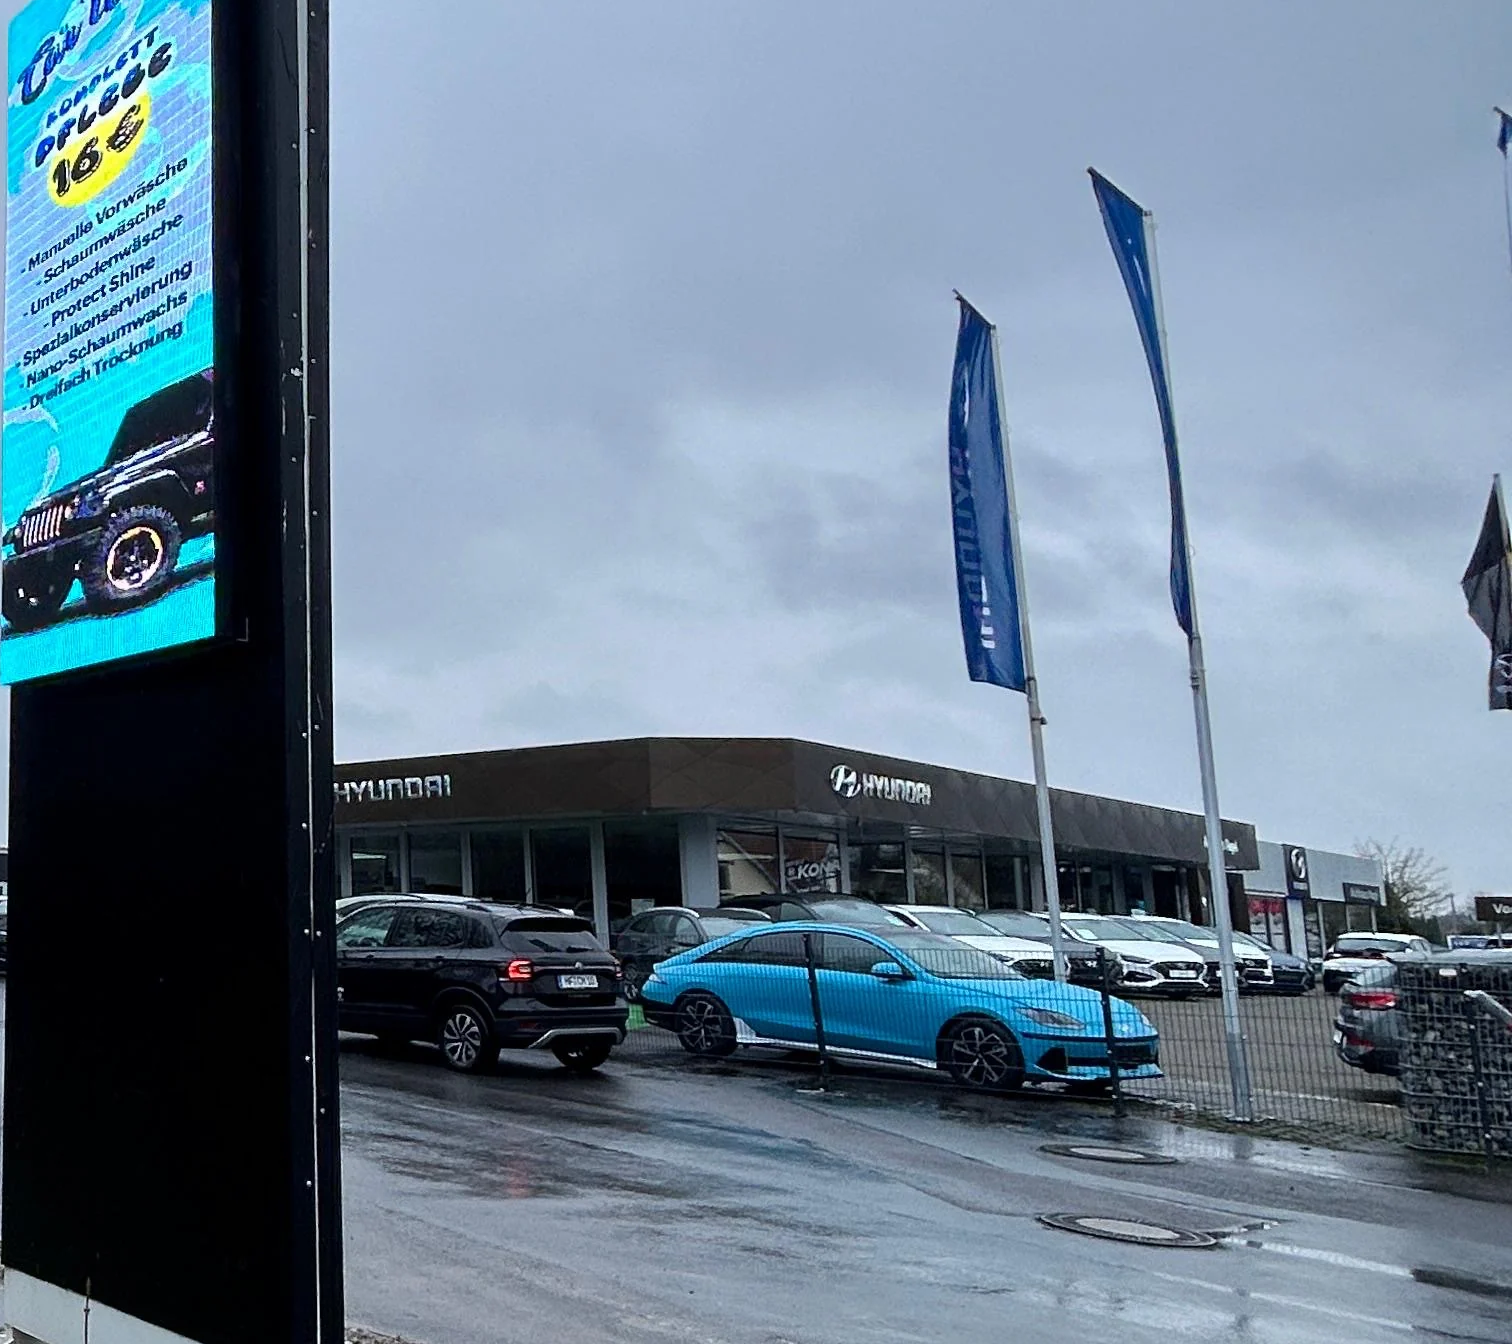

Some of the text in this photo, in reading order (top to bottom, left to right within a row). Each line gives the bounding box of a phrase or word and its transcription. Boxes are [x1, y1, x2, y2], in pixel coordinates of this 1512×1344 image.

[35, 42, 172, 168] PFLEGE
[45, 25, 159, 129] KOMPLETT
[53, 104, 145, 197] 16 €
[27, 157, 188, 271] Manuelle Vorwäsche
[43, 197, 167, 283] Schaumwäsche
[29, 213, 184, 316] Unterbodenwäsche
[51, 255, 157, 327] Protect Shine
[22, 259, 194, 367] Spezialkonservierung
[26, 290, 188, 388] Nano-Schaumwachs
[29, 320, 184, 410] Dreifach Trocknung
[333, 774, 451, 803] HYUNDAI
[861, 772, 932, 805] HYUNDAI
